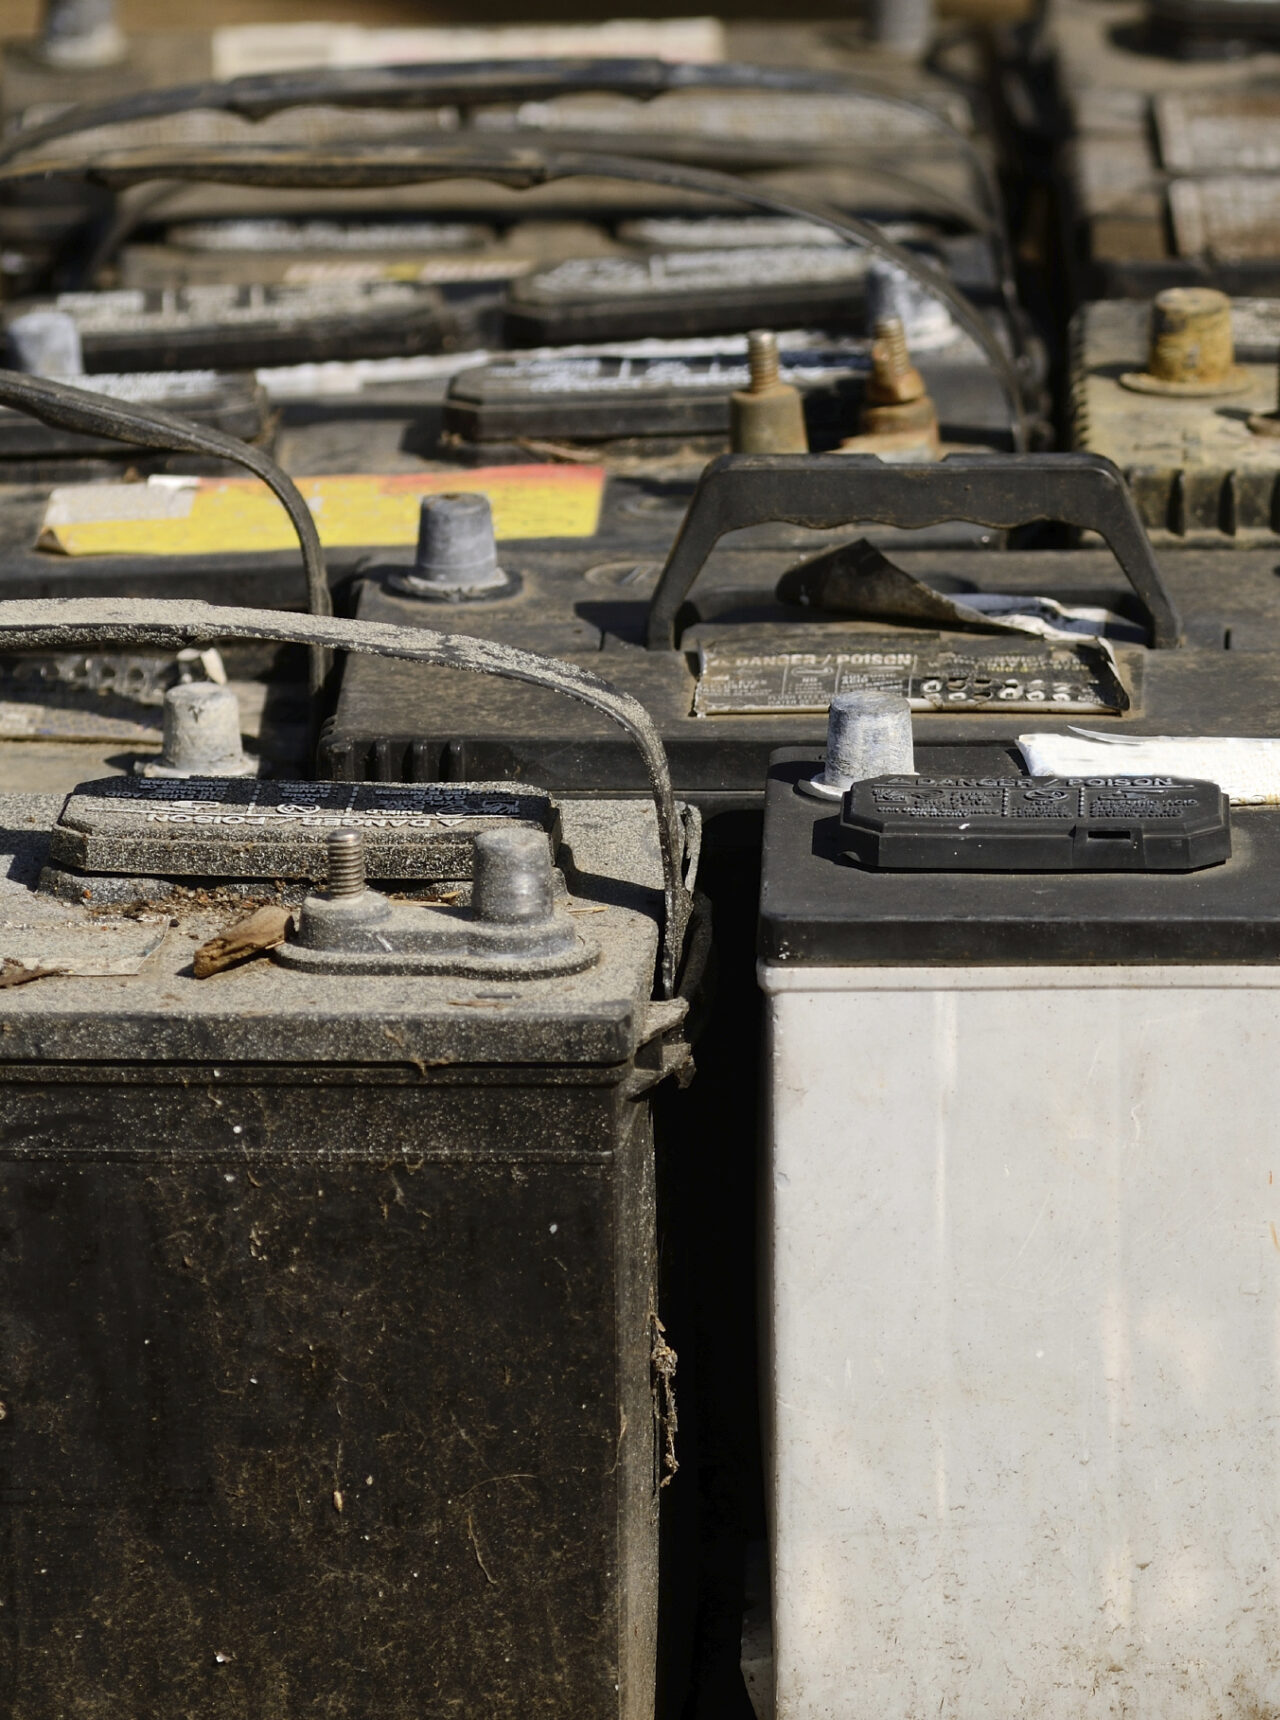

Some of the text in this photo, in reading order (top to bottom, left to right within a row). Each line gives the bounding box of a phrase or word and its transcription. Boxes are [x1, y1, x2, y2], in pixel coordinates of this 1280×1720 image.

[735, 654, 817, 666] DANGER
[836, 653, 912, 666] POISON
[915, 777, 1034, 788] DANGER
[1066, 777, 1173, 788] POISON
[144, 813, 266, 826] POISON
[302, 816, 431, 828] DANGER
